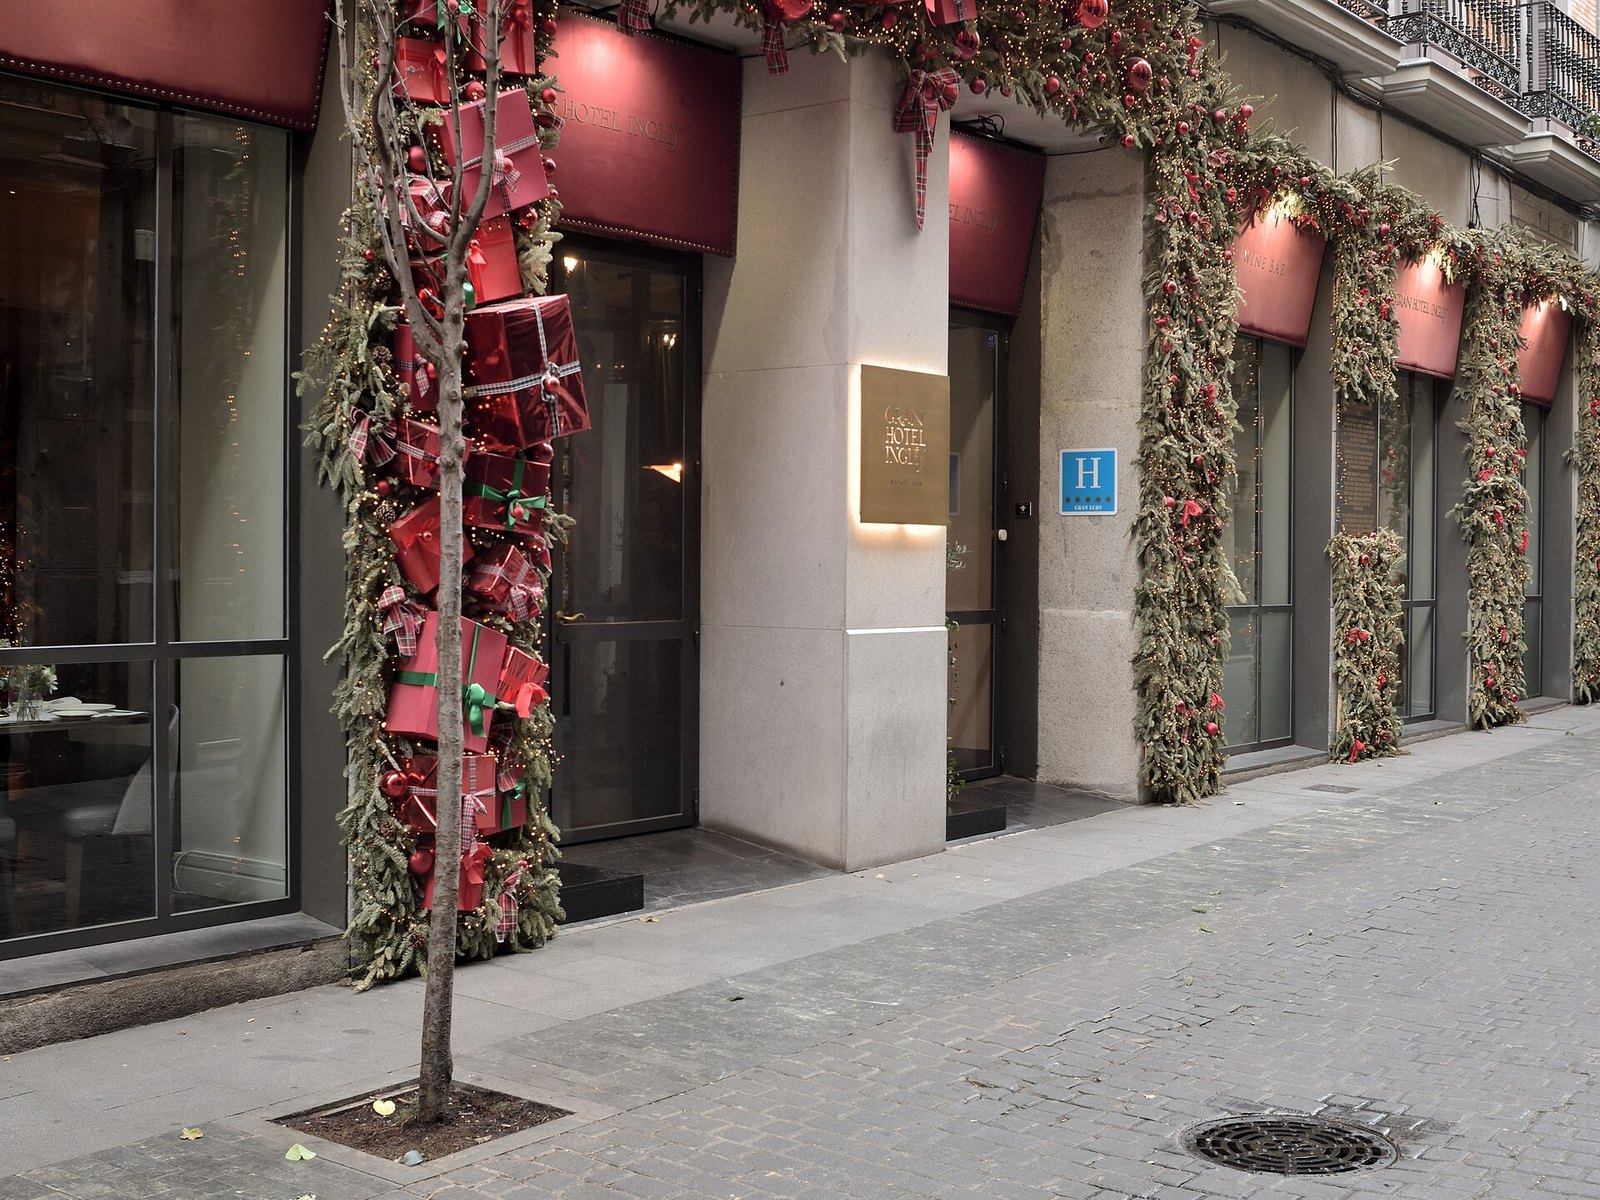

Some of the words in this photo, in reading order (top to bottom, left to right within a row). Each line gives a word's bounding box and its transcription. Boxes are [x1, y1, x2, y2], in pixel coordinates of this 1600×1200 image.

[563, 99, 621, 132] HOTEL
[1243, 249, 1267, 270] WINE
[1269, 259, 1286, 277] BAR
[1412, 297, 1430, 315] HOTEL
[885, 406, 923, 427] GRAN
[885, 426, 926, 447] HOTEL
[1075, 457, 1101, 489] H
